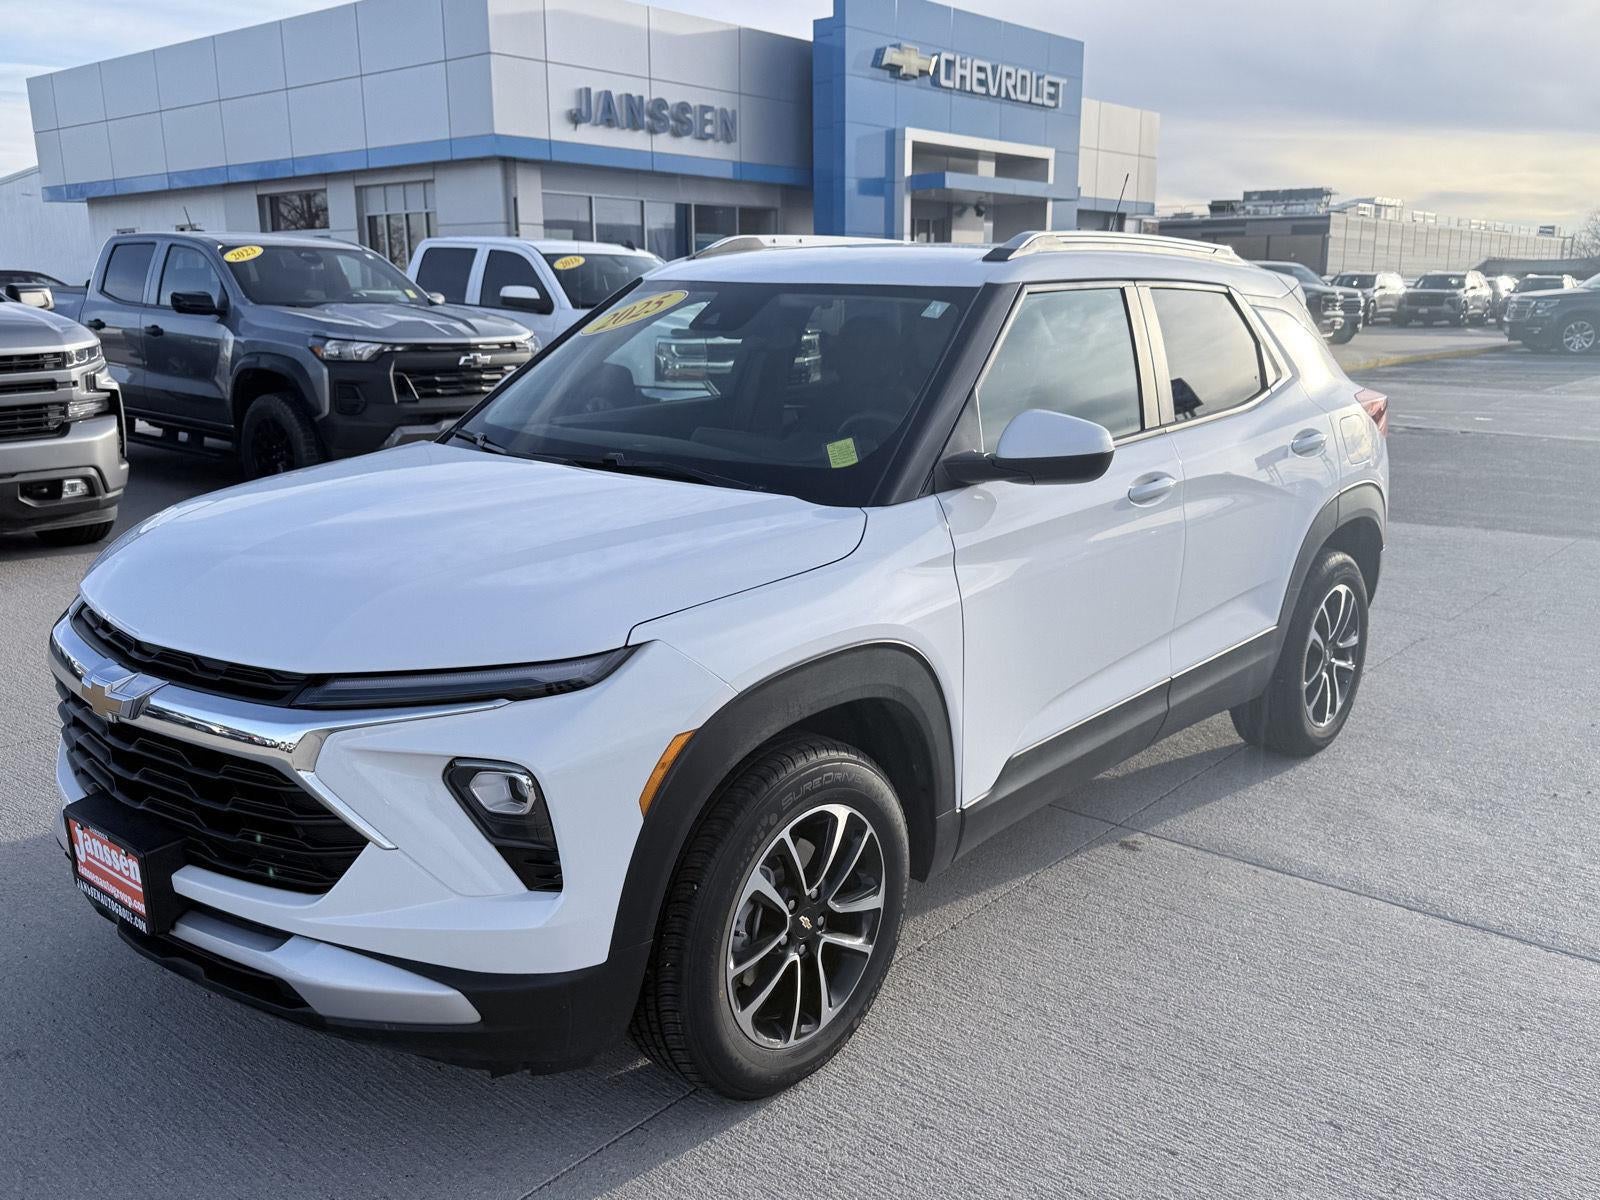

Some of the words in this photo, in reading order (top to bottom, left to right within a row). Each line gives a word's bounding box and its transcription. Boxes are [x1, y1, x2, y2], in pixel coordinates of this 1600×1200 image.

[938, 51, 1068, 109] CHEVROLET
[567, 86, 738, 144] JANSSEN
[593, 293, 674, 332] 2025
[74, 825, 142, 884] Janssen
